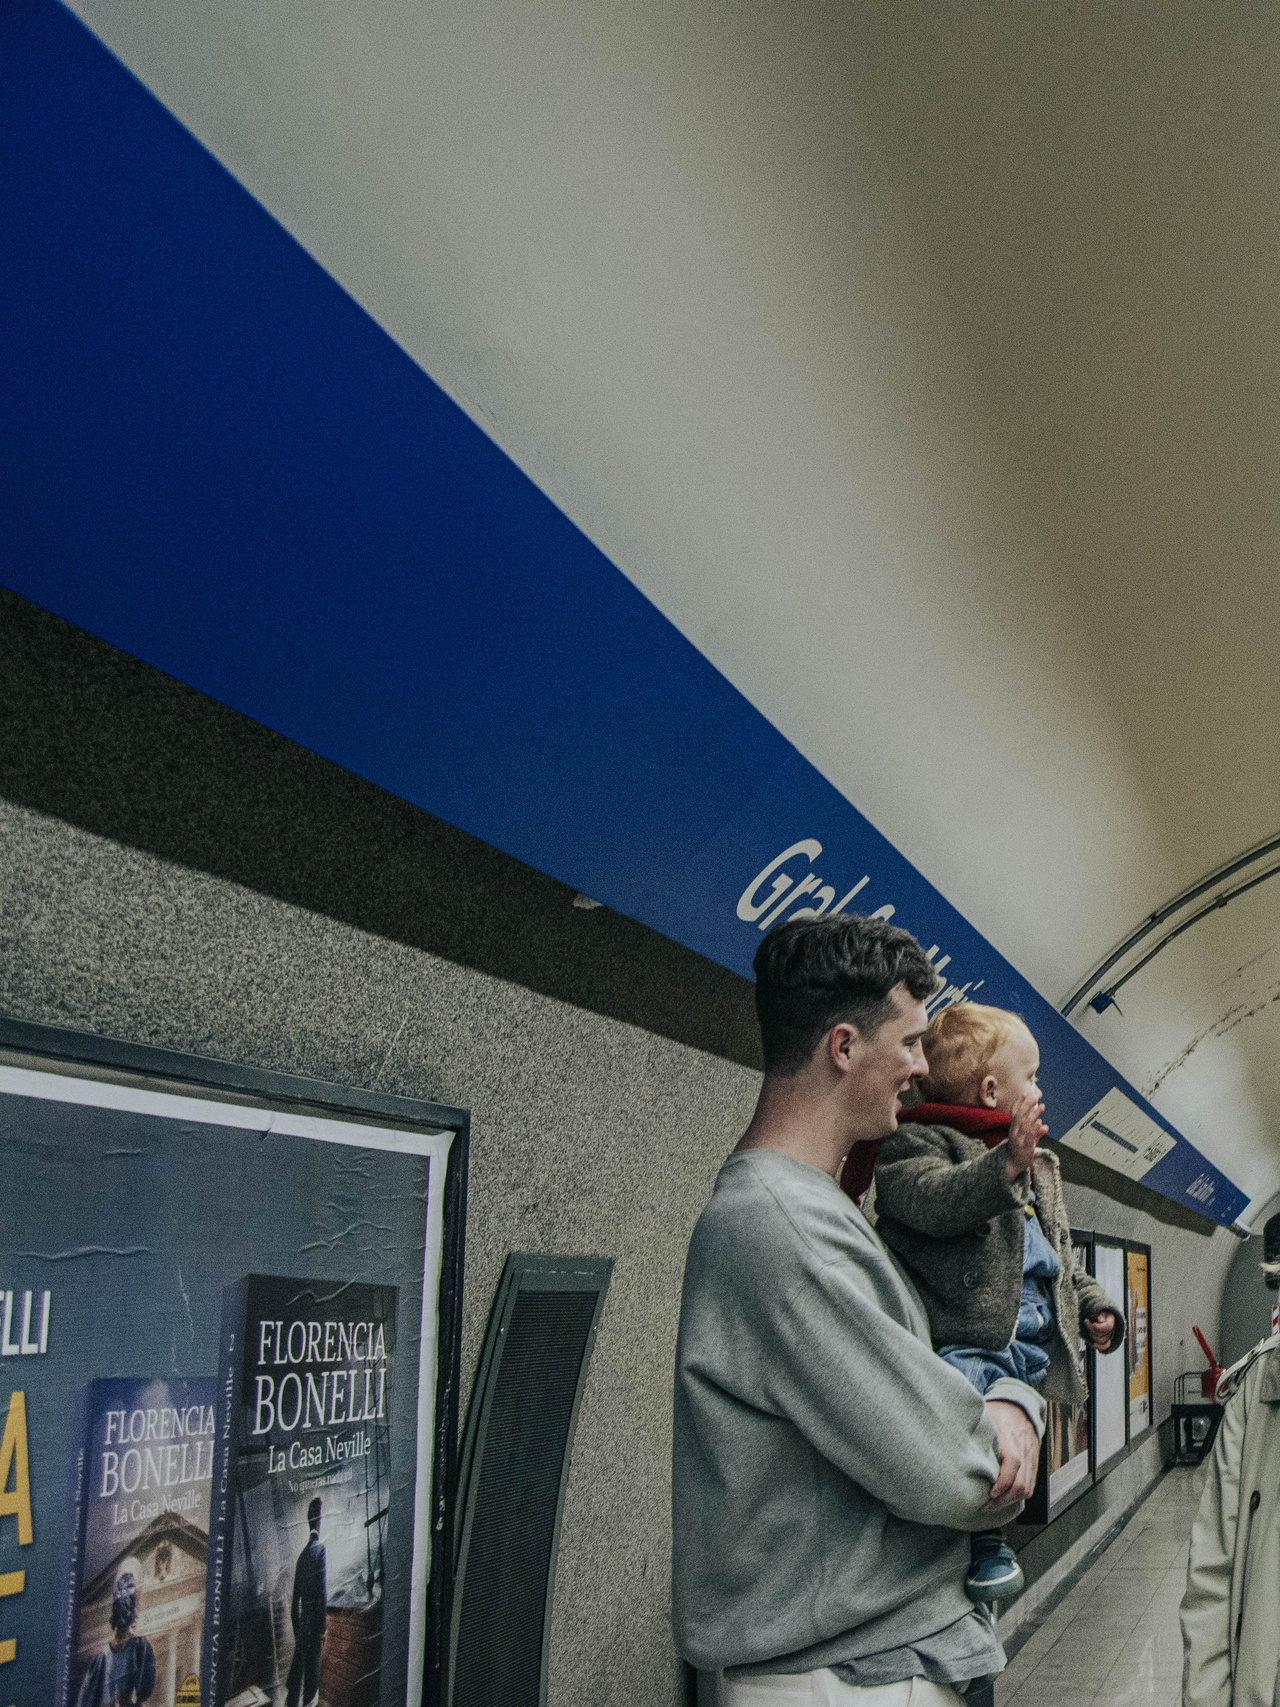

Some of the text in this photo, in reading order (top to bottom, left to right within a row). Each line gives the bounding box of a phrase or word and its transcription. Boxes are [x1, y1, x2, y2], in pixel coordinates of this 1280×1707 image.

[0, 1290, 51, 1356] LLI
[257, 1320, 387, 1365] FLORENCIA
[105, 1405, 216, 1445] FLORENCIA
[252, 1367, 387, 1435] BONELLI
[100, 1440, 215, 1497] BONELLI
[267, 1431, 371, 1474] La Casa Neville
[113, 1489, 201, 1525] La Casa Neville
[213, 1535, 225, 1626] BONELLI
[222, 1367, 234, 1439] Neville
